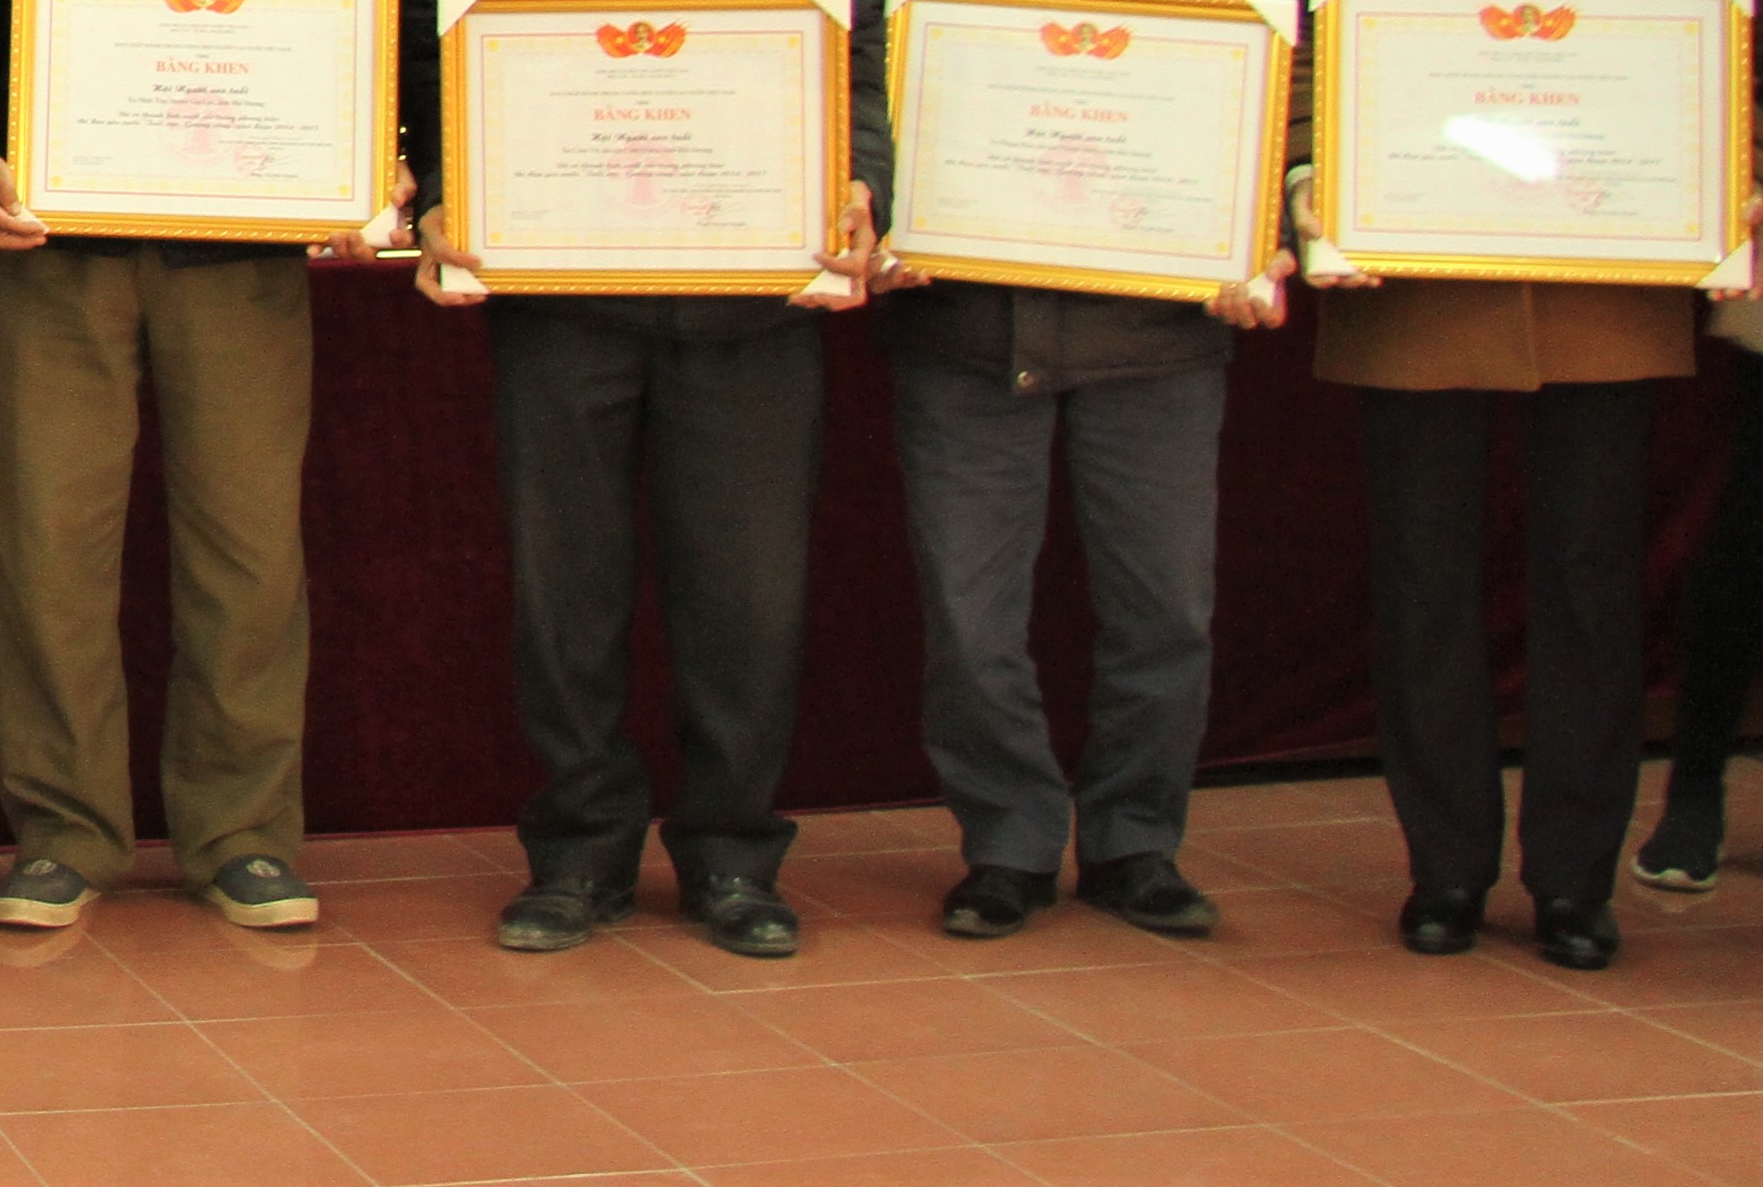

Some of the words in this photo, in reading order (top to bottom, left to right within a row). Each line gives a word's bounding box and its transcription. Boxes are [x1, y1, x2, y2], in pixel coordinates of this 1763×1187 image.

[155, 56, 199, 74] BẰNG
[204, 61, 249, 75] KHEN
[1474, 85, 1524, 105] BẰNG
[1529, 91, 1579, 105] KHEN
[593, 104, 640, 121] BẰNG
[644, 108, 691, 121] KHEN
[1080, 108, 1128, 123] KHEN
